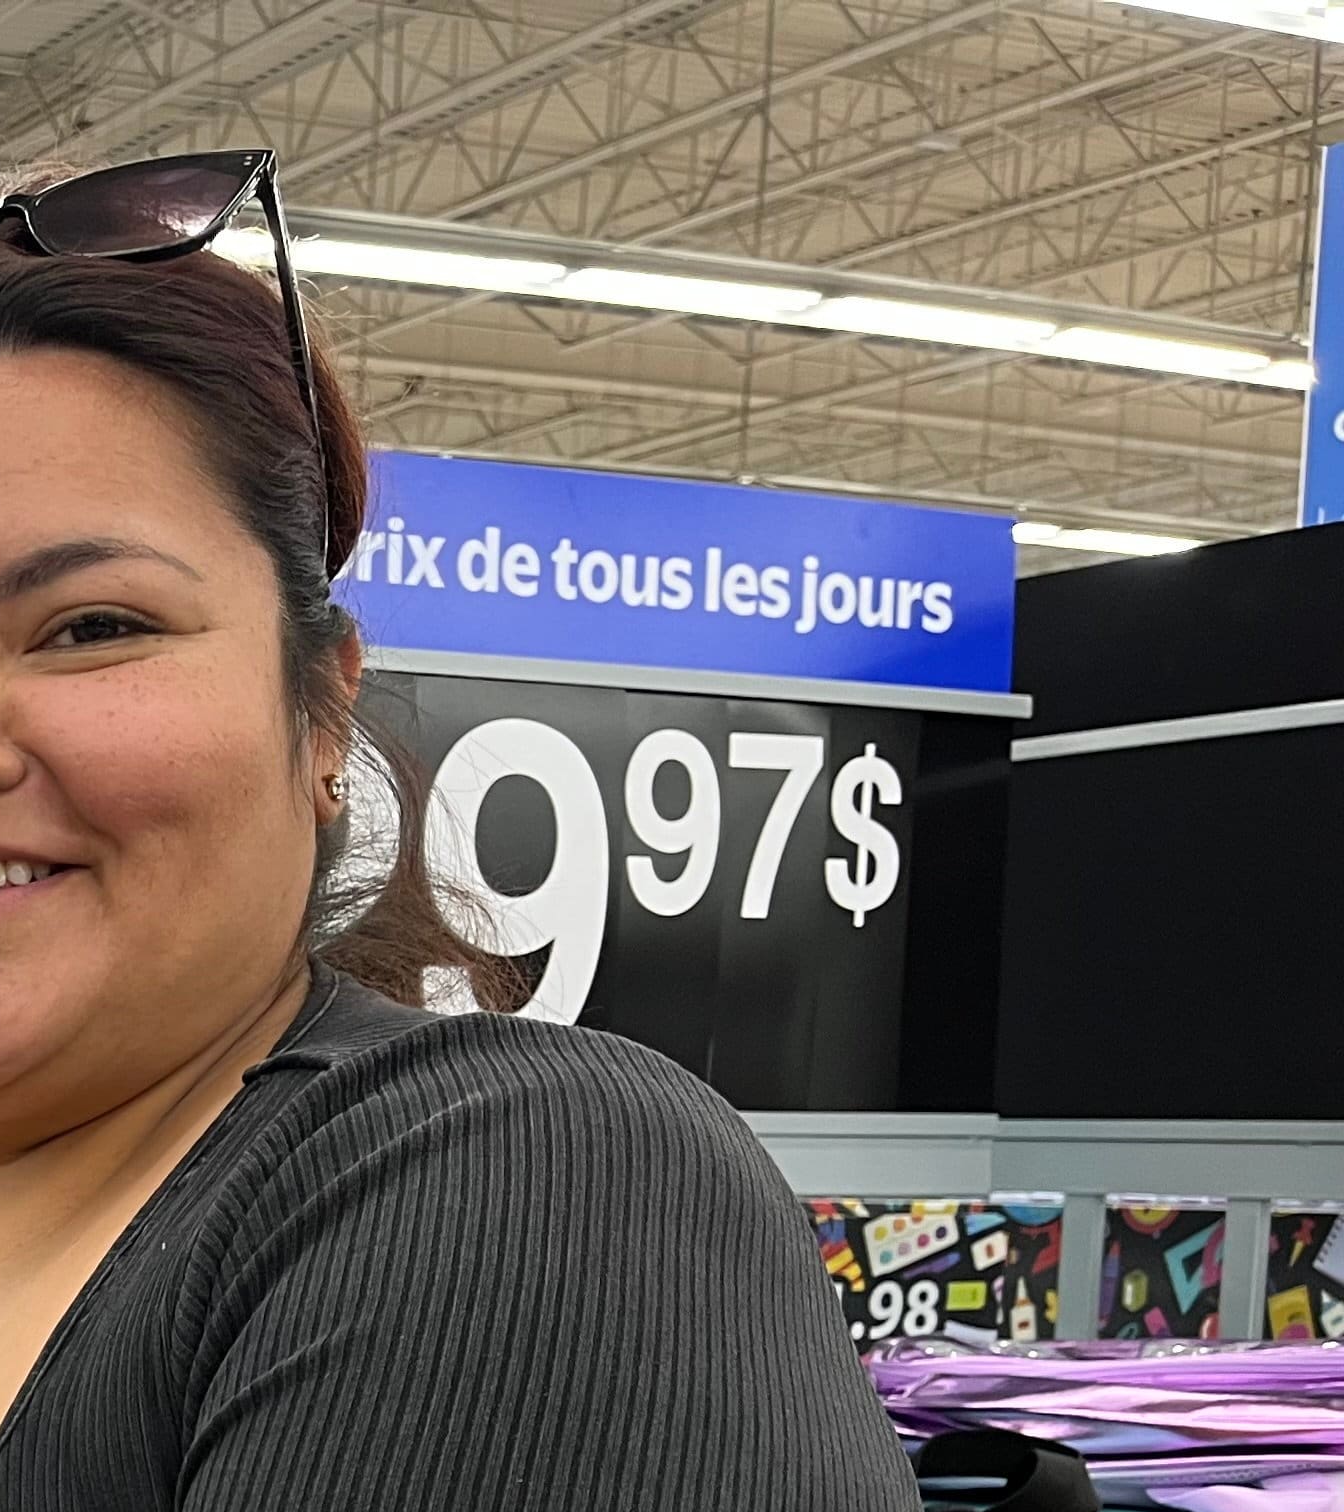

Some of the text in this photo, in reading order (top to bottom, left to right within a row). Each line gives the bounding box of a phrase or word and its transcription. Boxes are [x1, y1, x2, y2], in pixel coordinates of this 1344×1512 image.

[457, 526, 540, 596] de
[553, 538, 693, 612] tous
[707, 548, 790, 620] les
[795, 555, 953, 635] jours
